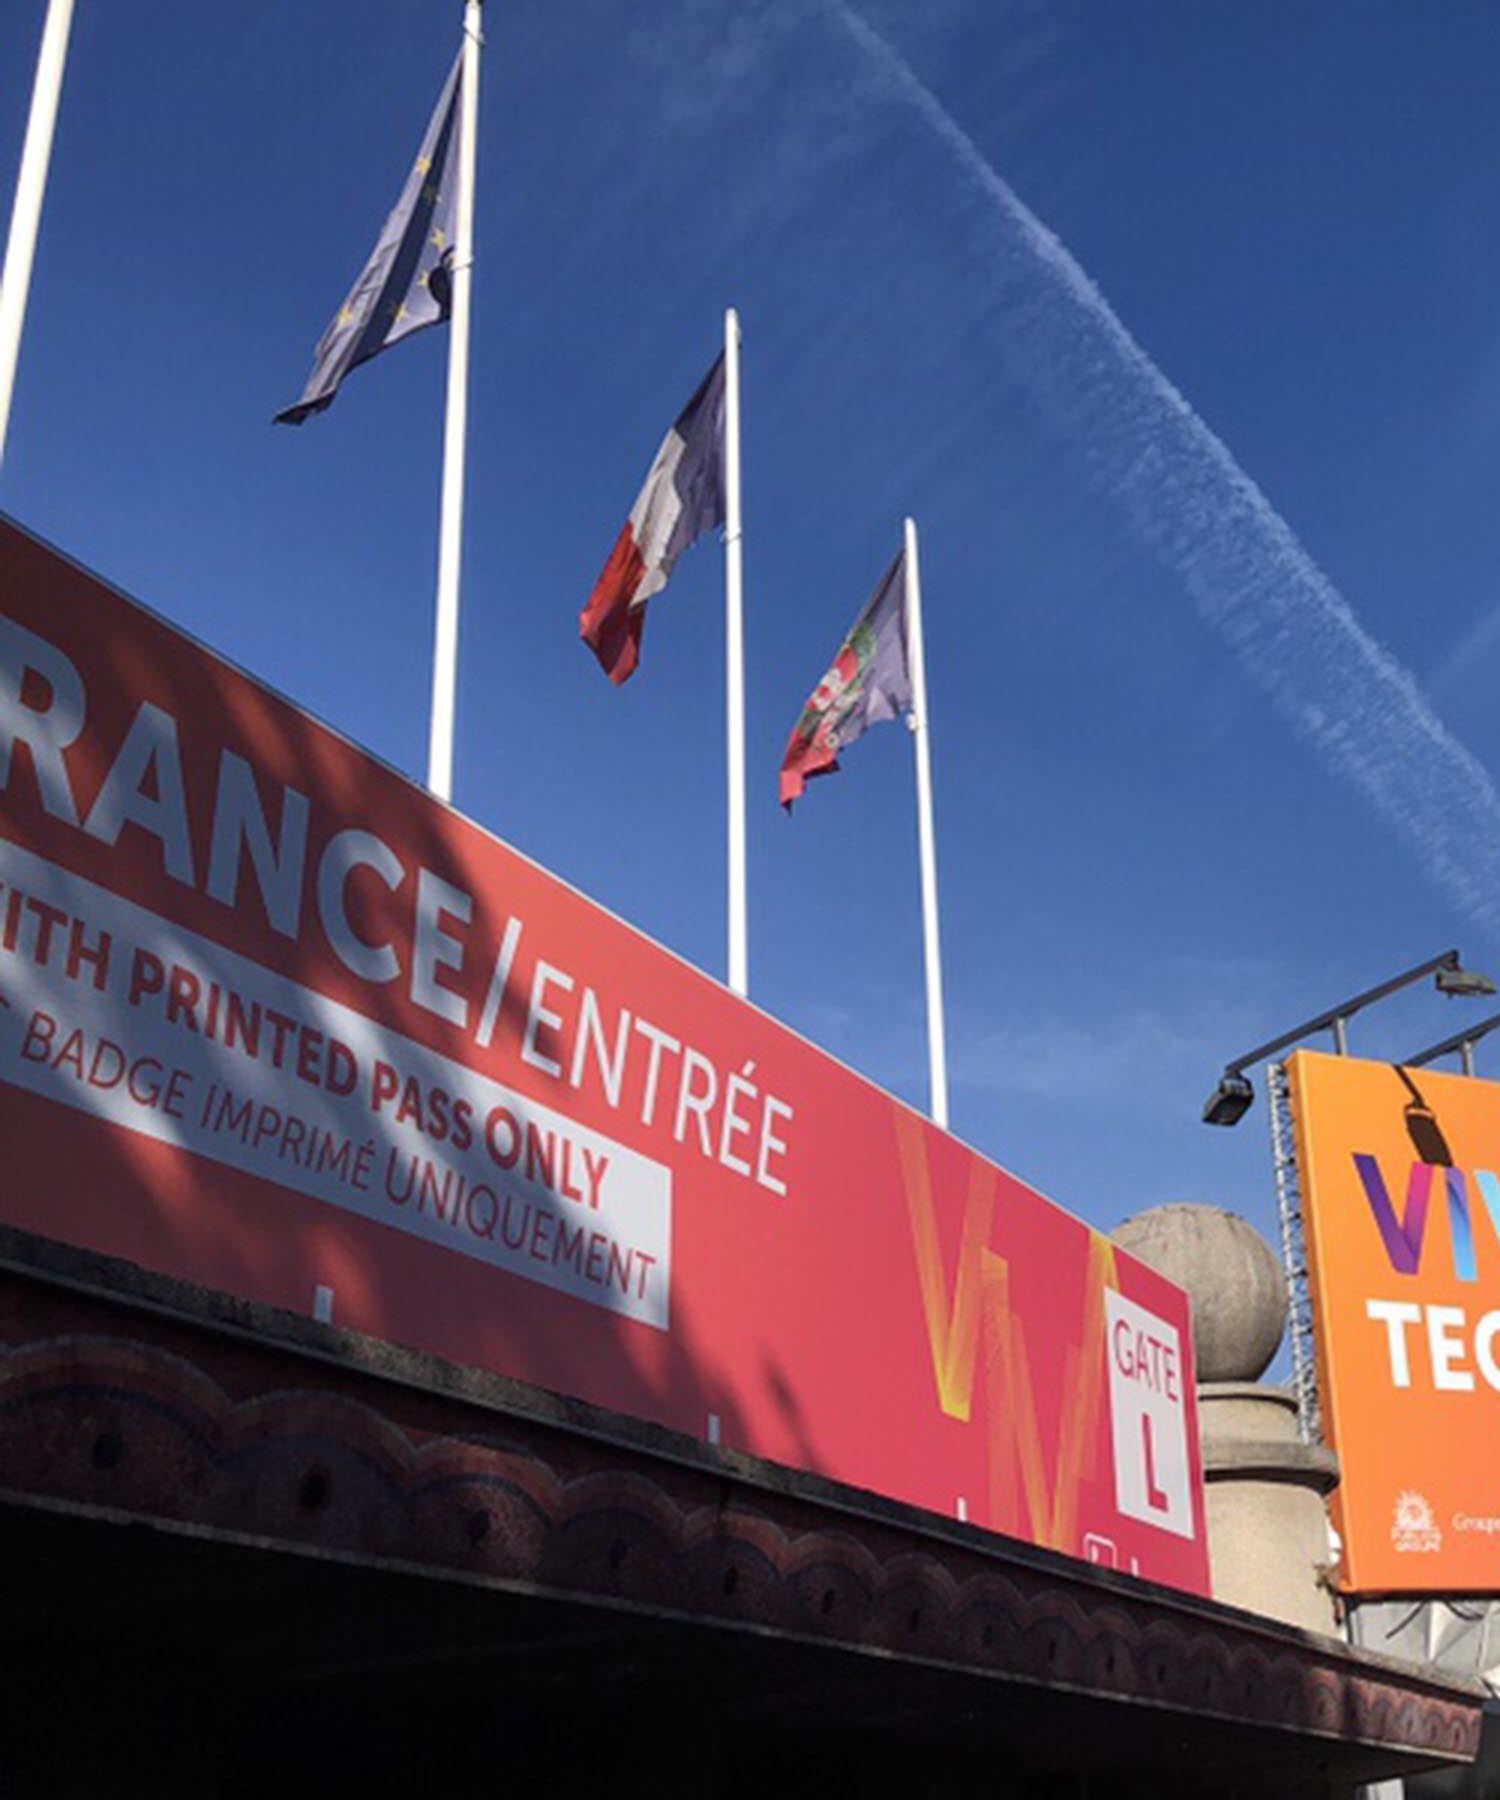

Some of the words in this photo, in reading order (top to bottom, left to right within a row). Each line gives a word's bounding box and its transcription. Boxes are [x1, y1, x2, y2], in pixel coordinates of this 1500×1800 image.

[0, 882, 111, 991] ITH
[129, 946, 358, 1096] PRINTED
[371, 1060, 472, 1150] PASS
[485, 1105, 609, 1211] ONLY
[20, 1010, 193, 1120] BADGE
[201, 1084, 376, 1191] IMPRIMÉ
[385, 1146, 656, 1300] UNIQUEMENT
[1114, 1319, 1178, 1402] GATE
[1142, 1413, 1168, 1511] L
